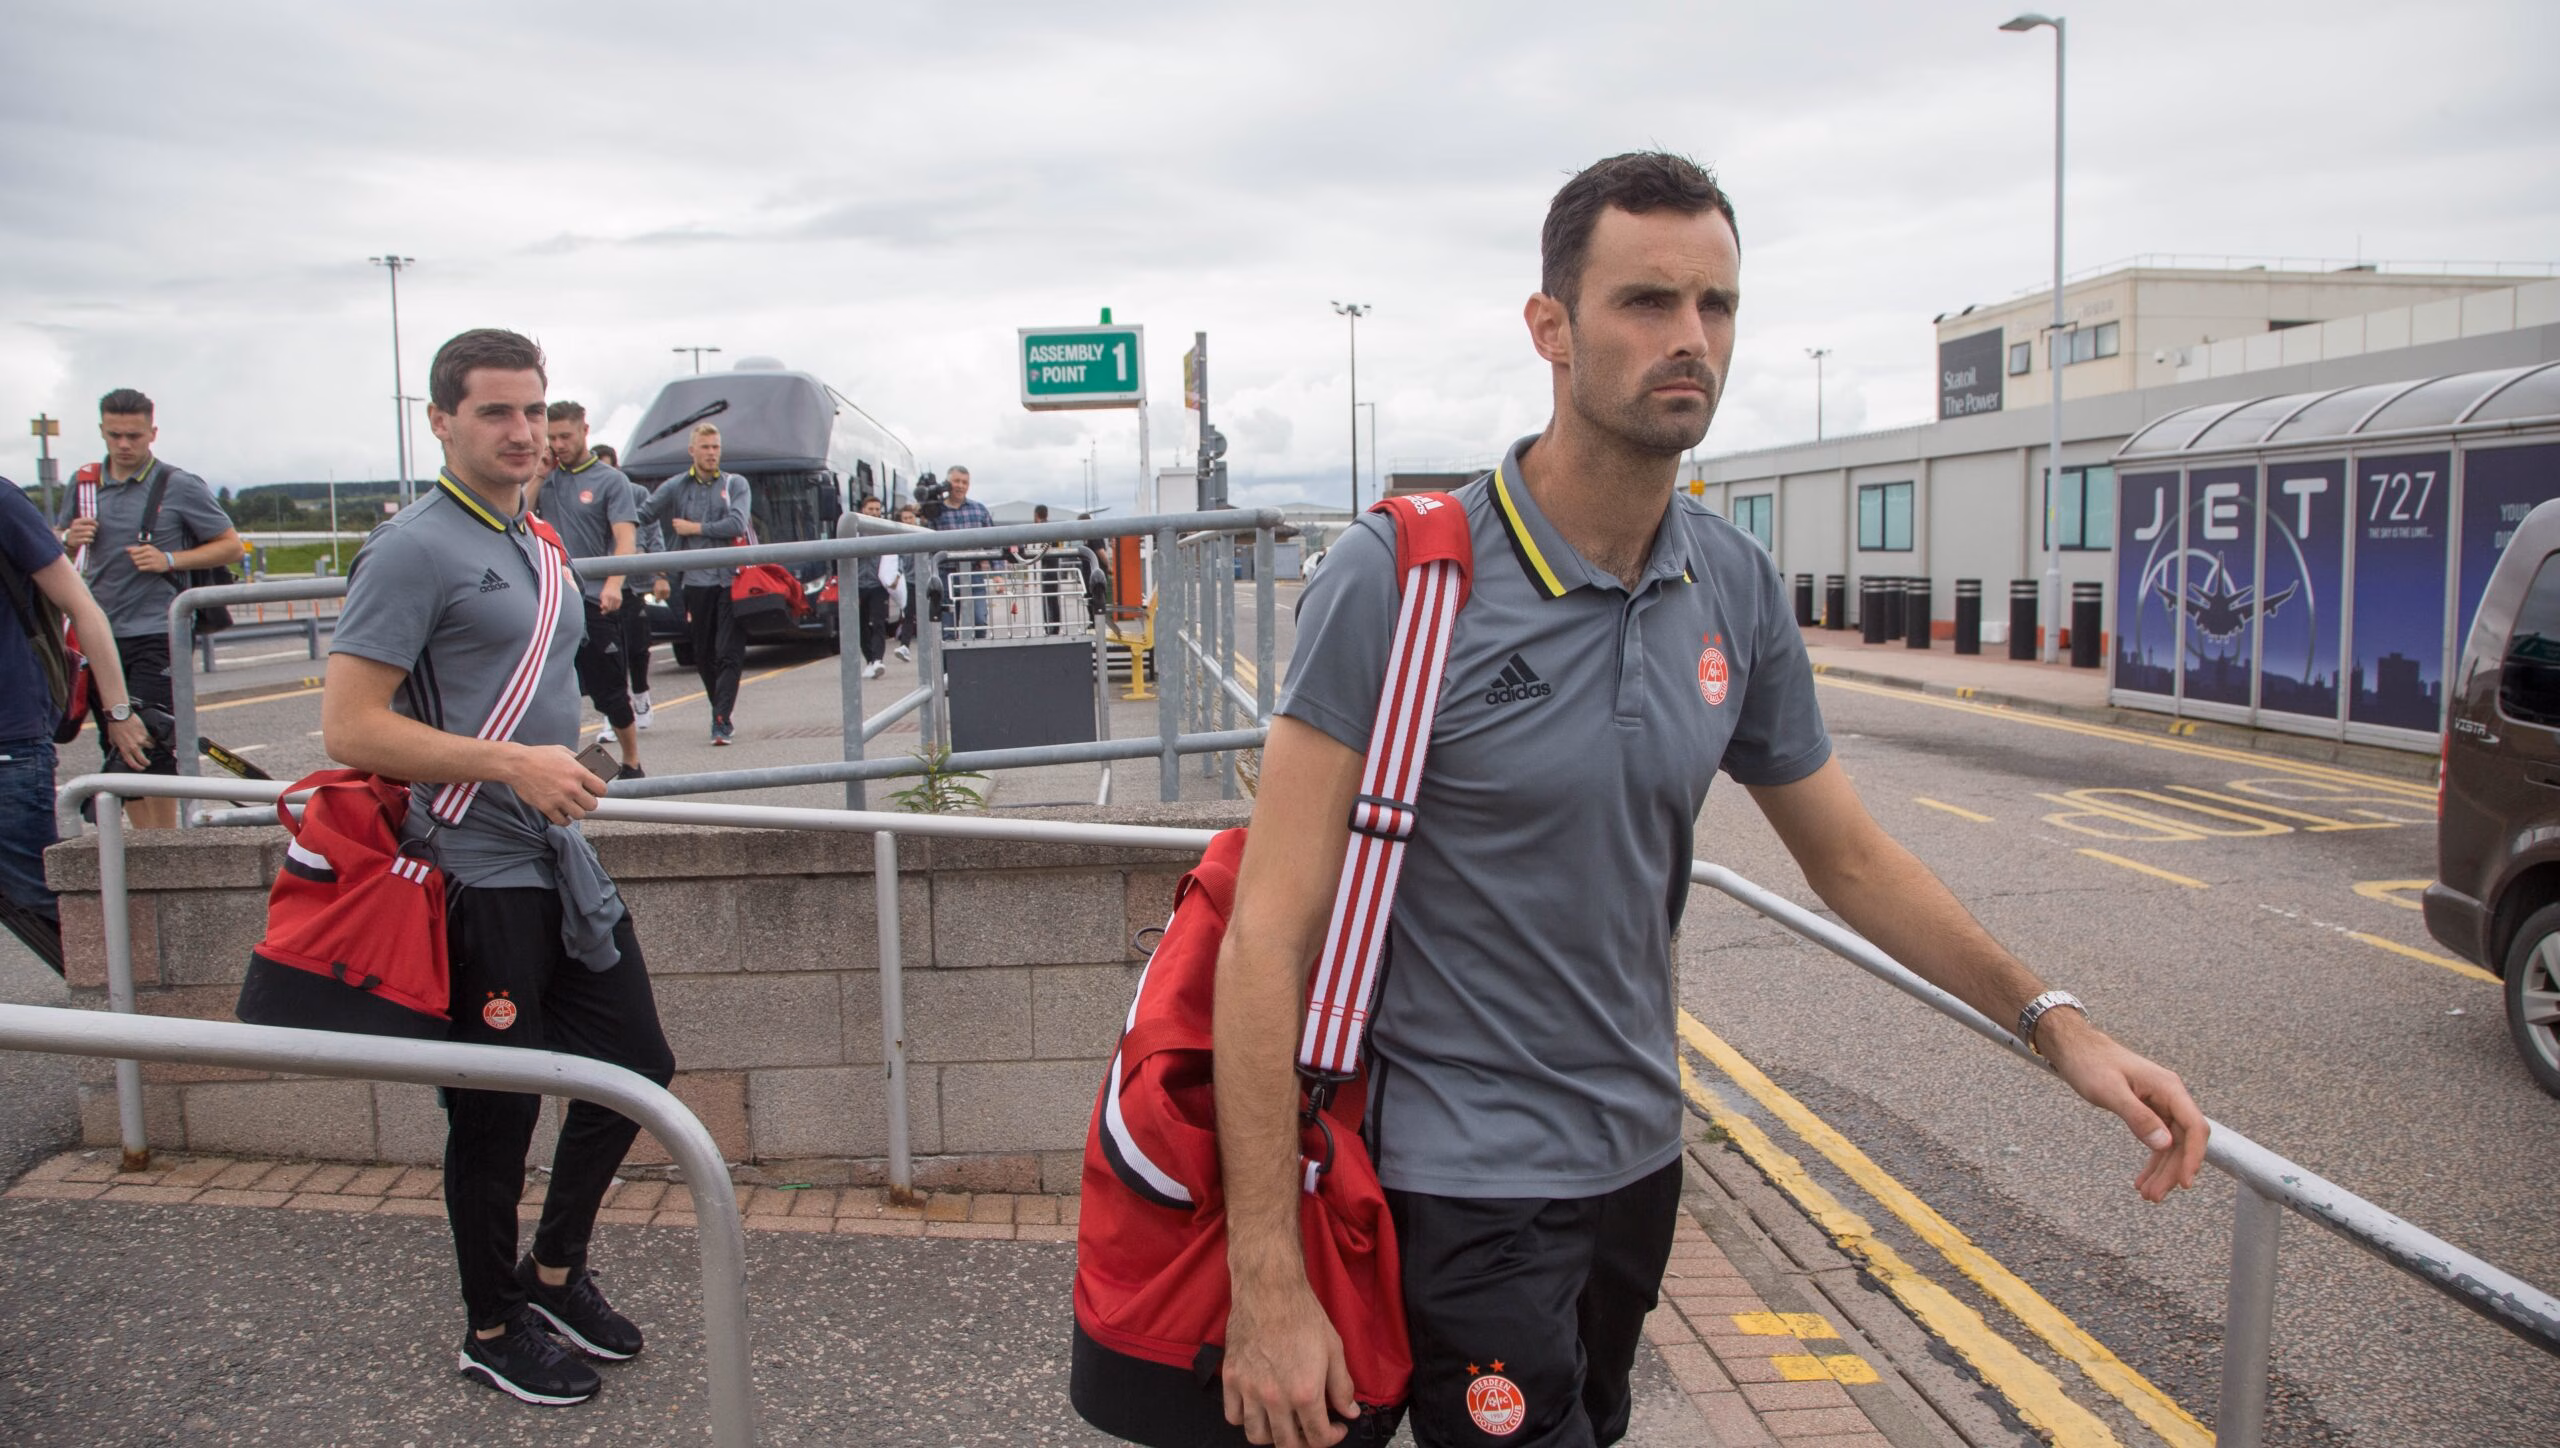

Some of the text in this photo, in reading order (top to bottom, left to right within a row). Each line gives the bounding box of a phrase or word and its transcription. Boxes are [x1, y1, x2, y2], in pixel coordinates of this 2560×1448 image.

[1029, 344, 1105, 363] ASSEMBLY
[1112, 342, 1127, 382] 1
[1042, 365, 1087, 383] POINT
[1944, 392, 1999, 416] The Power
[2370, 471, 2436, 521] 727
[1485, 681, 1551, 705] adidas
[1472, 1379, 1512, 1396] ABERDEEN
[1473, 1404, 1522, 1432] FOOTBALL CLUB
